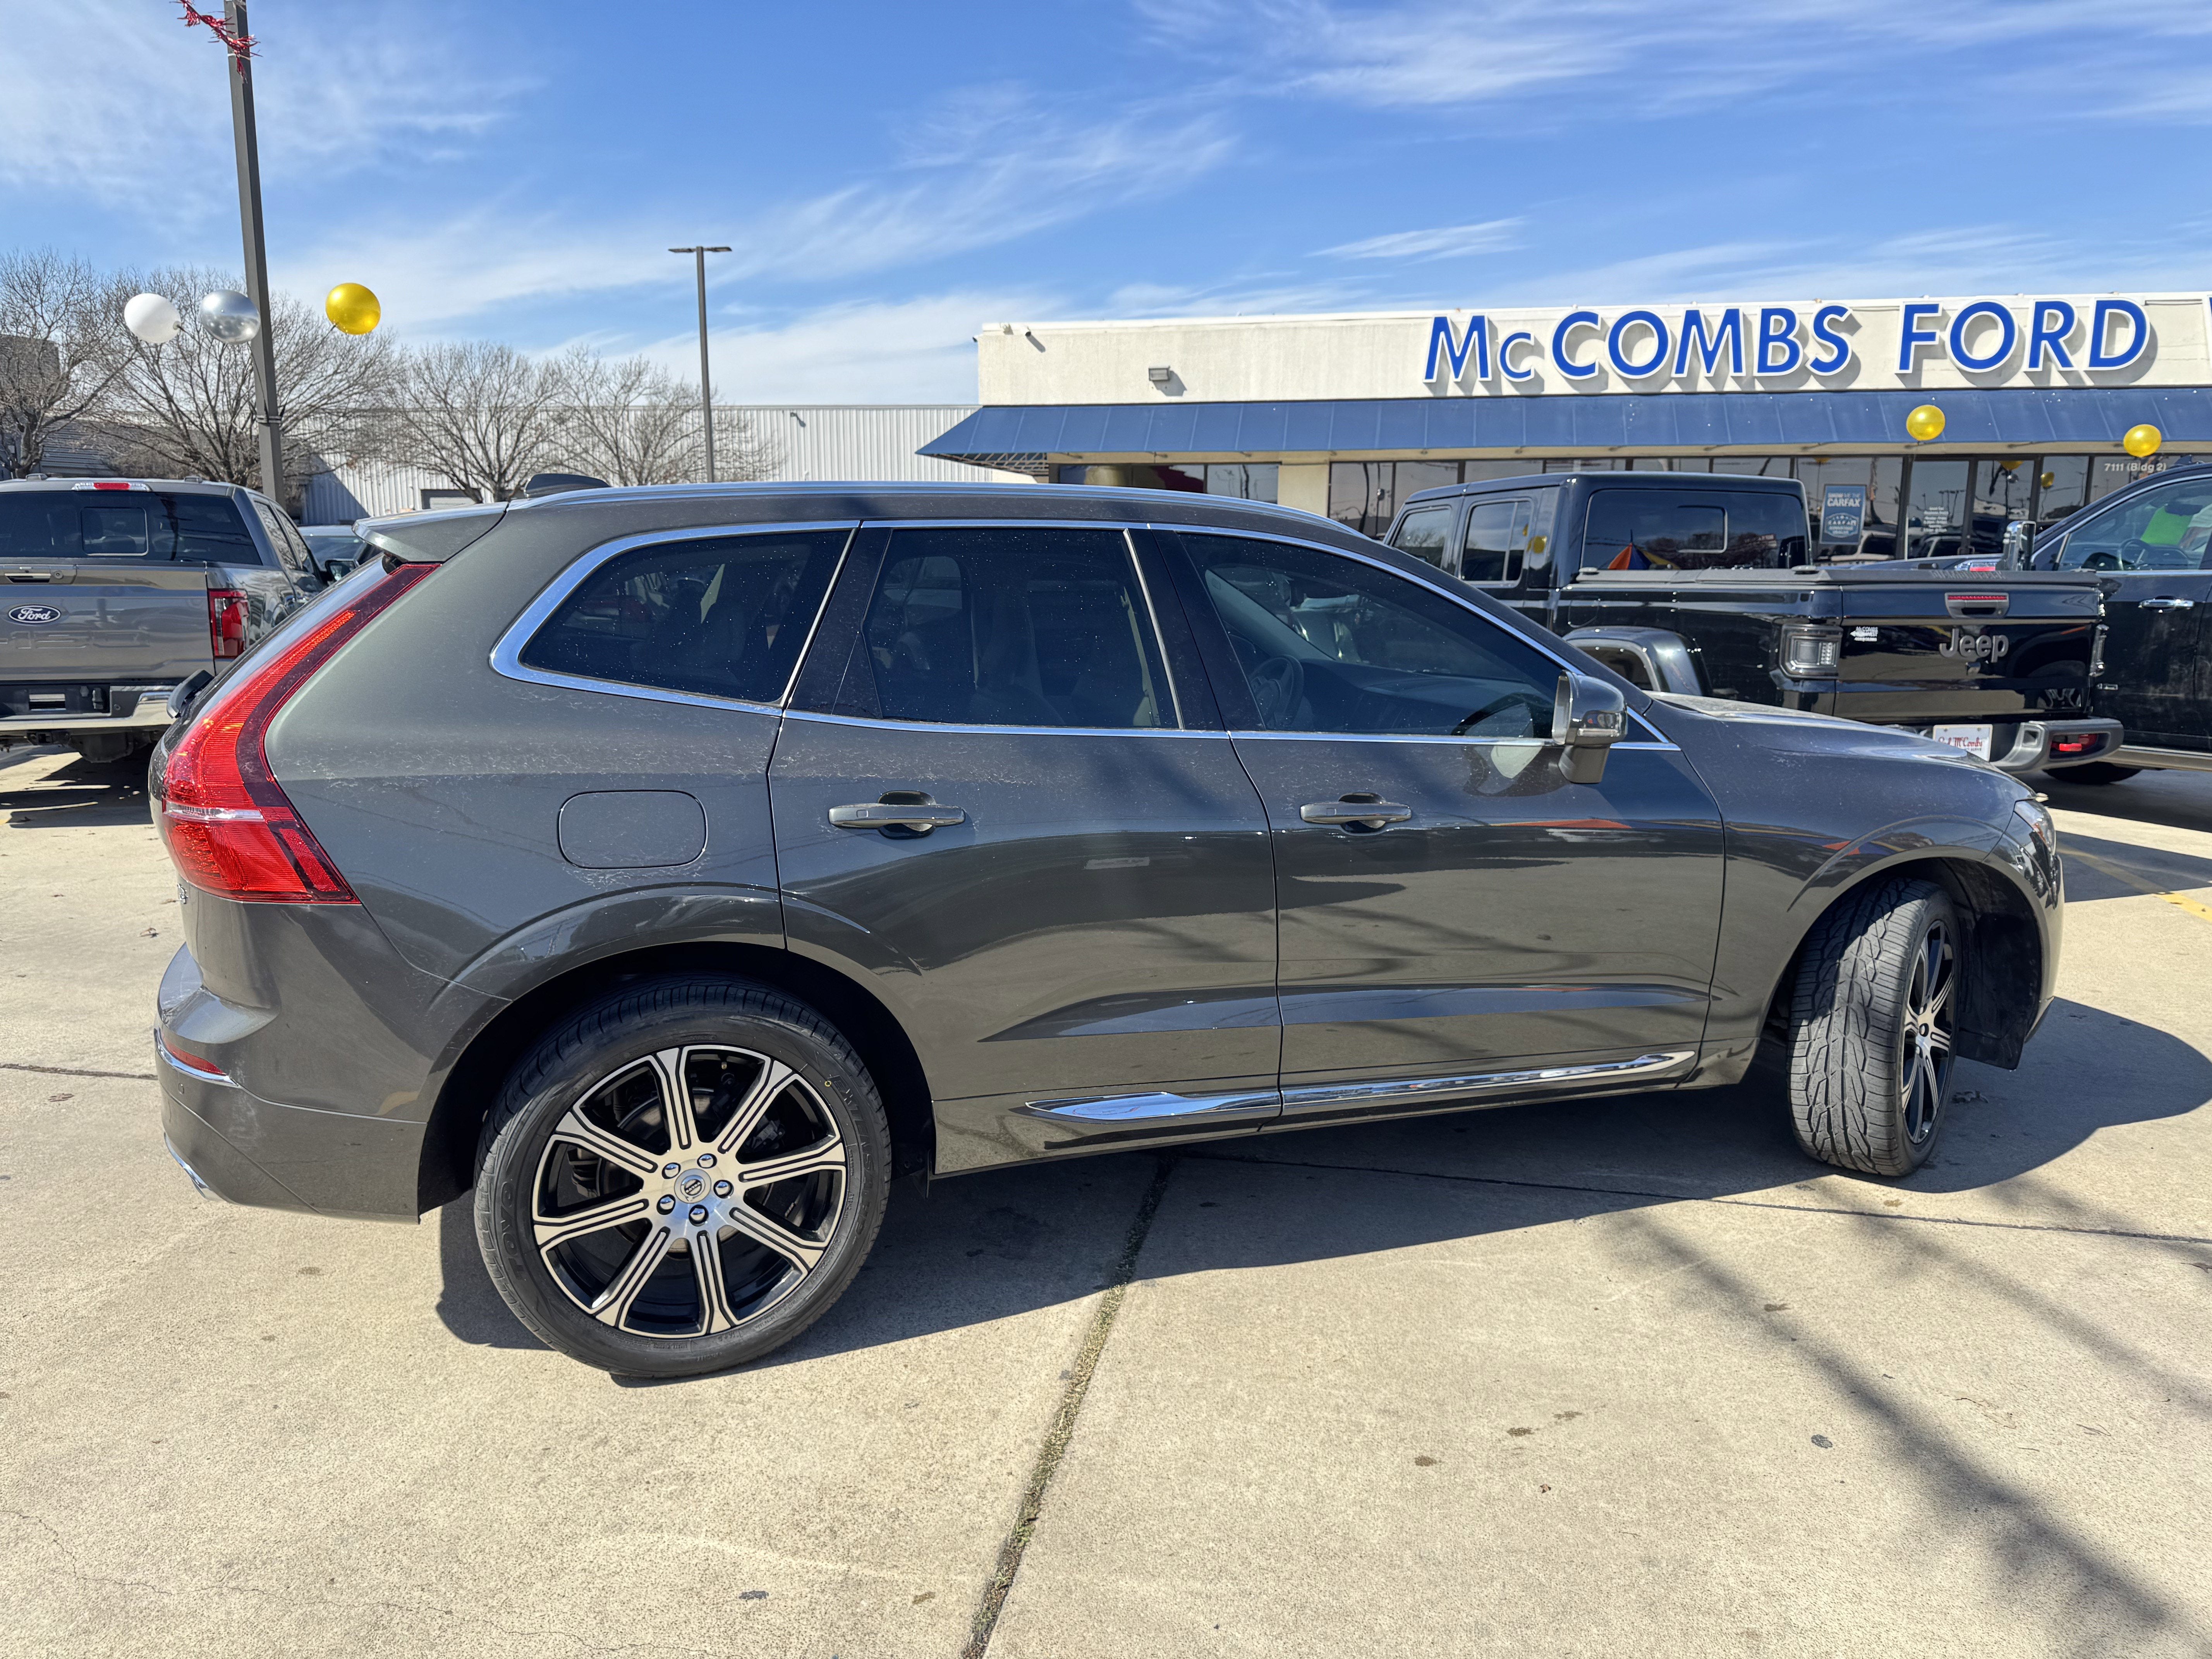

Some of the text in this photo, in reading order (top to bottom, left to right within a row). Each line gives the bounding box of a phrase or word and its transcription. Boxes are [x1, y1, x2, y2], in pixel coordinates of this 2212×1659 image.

[1896, 298, 2150, 372] FORD
[2156, 463, 2167, 471] 2)
[1827, 498, 1861, 507] CARFAX
[18, 608, 51, 620] Ford
[1939, 628, 2009, 663] Jeep
[501, 1181, 524, 1280] TOYO
